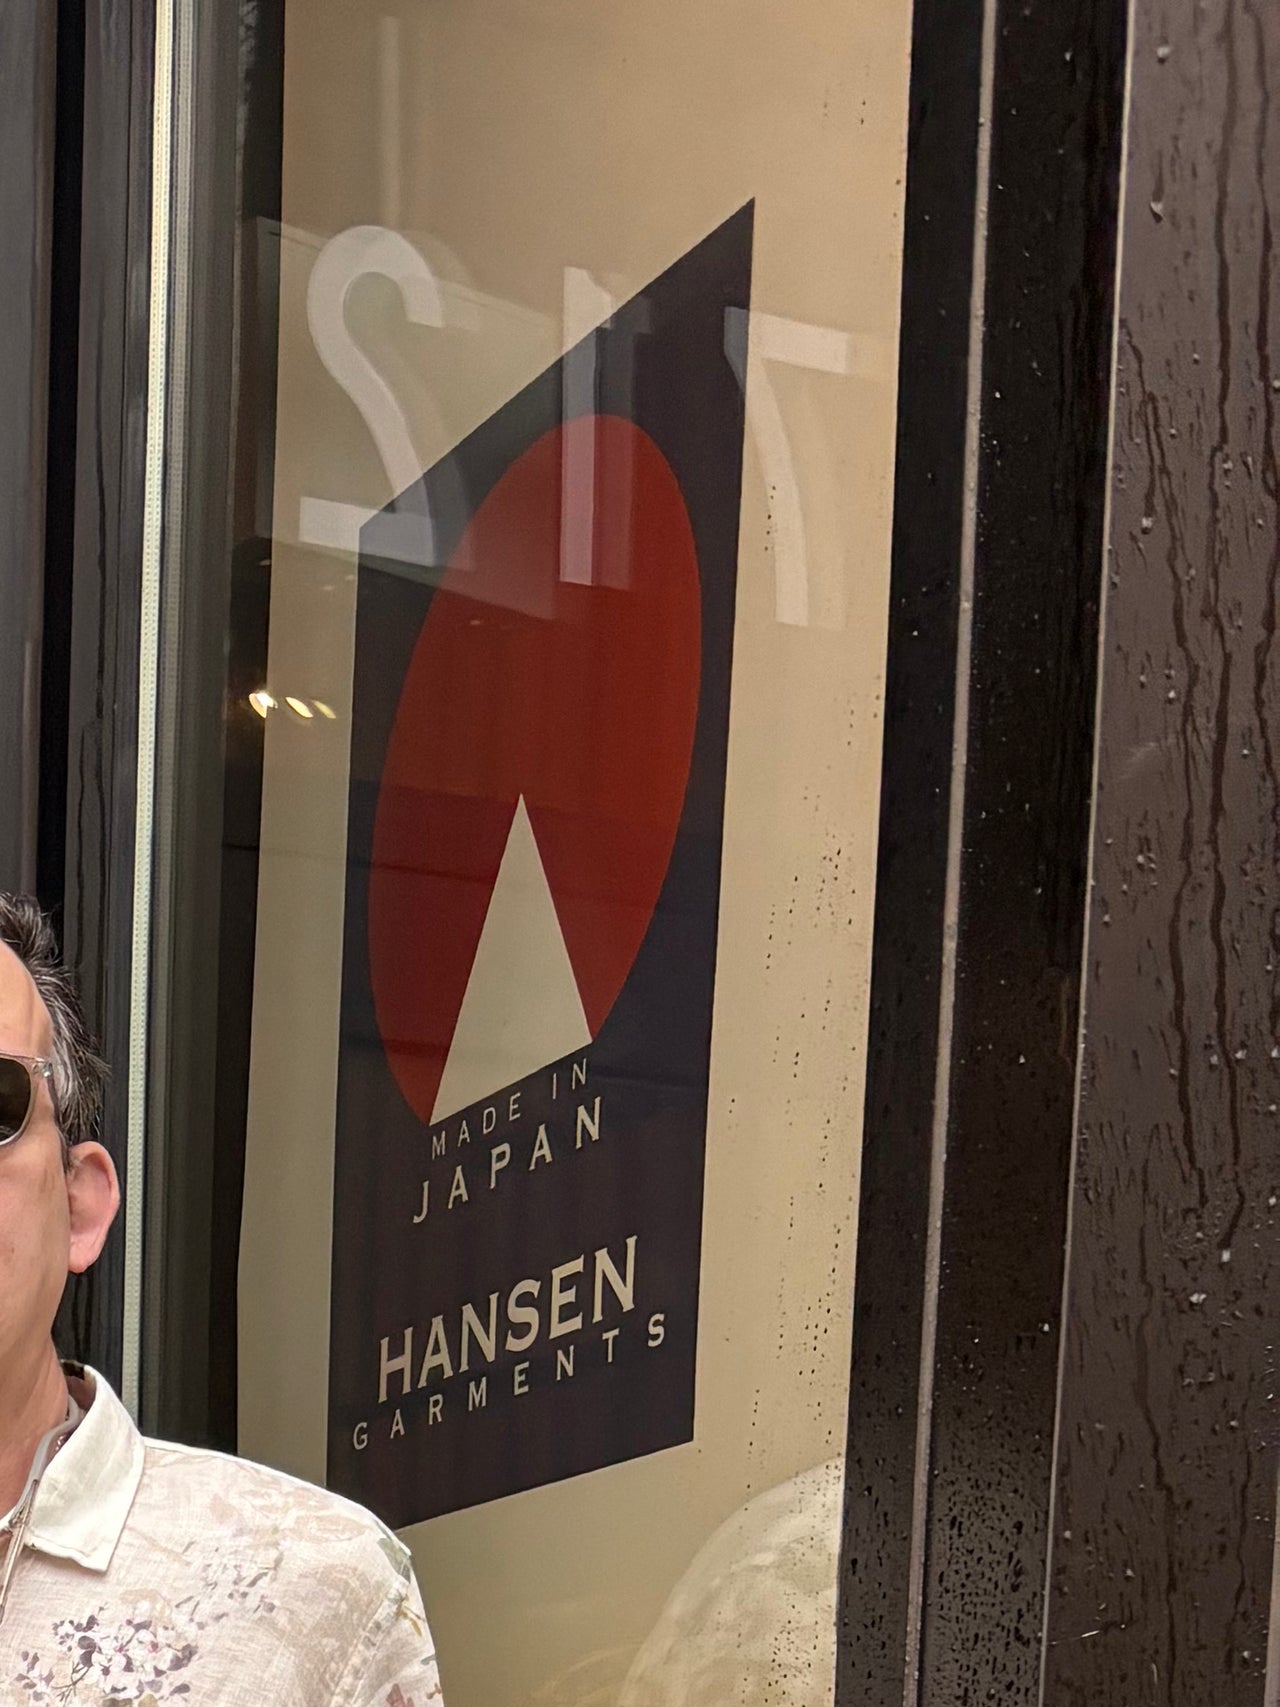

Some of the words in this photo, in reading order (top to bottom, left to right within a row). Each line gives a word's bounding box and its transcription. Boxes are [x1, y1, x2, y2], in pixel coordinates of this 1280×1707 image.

[413, 1098, 601, 1223] JAPAN
[432, 1093, 521, 1159] MADE
[552, 1058, 587, 1100] IN
[353, 1313, 665, 1450] GARMENTS
[378, 1235, 637, 1403] HANSEN
